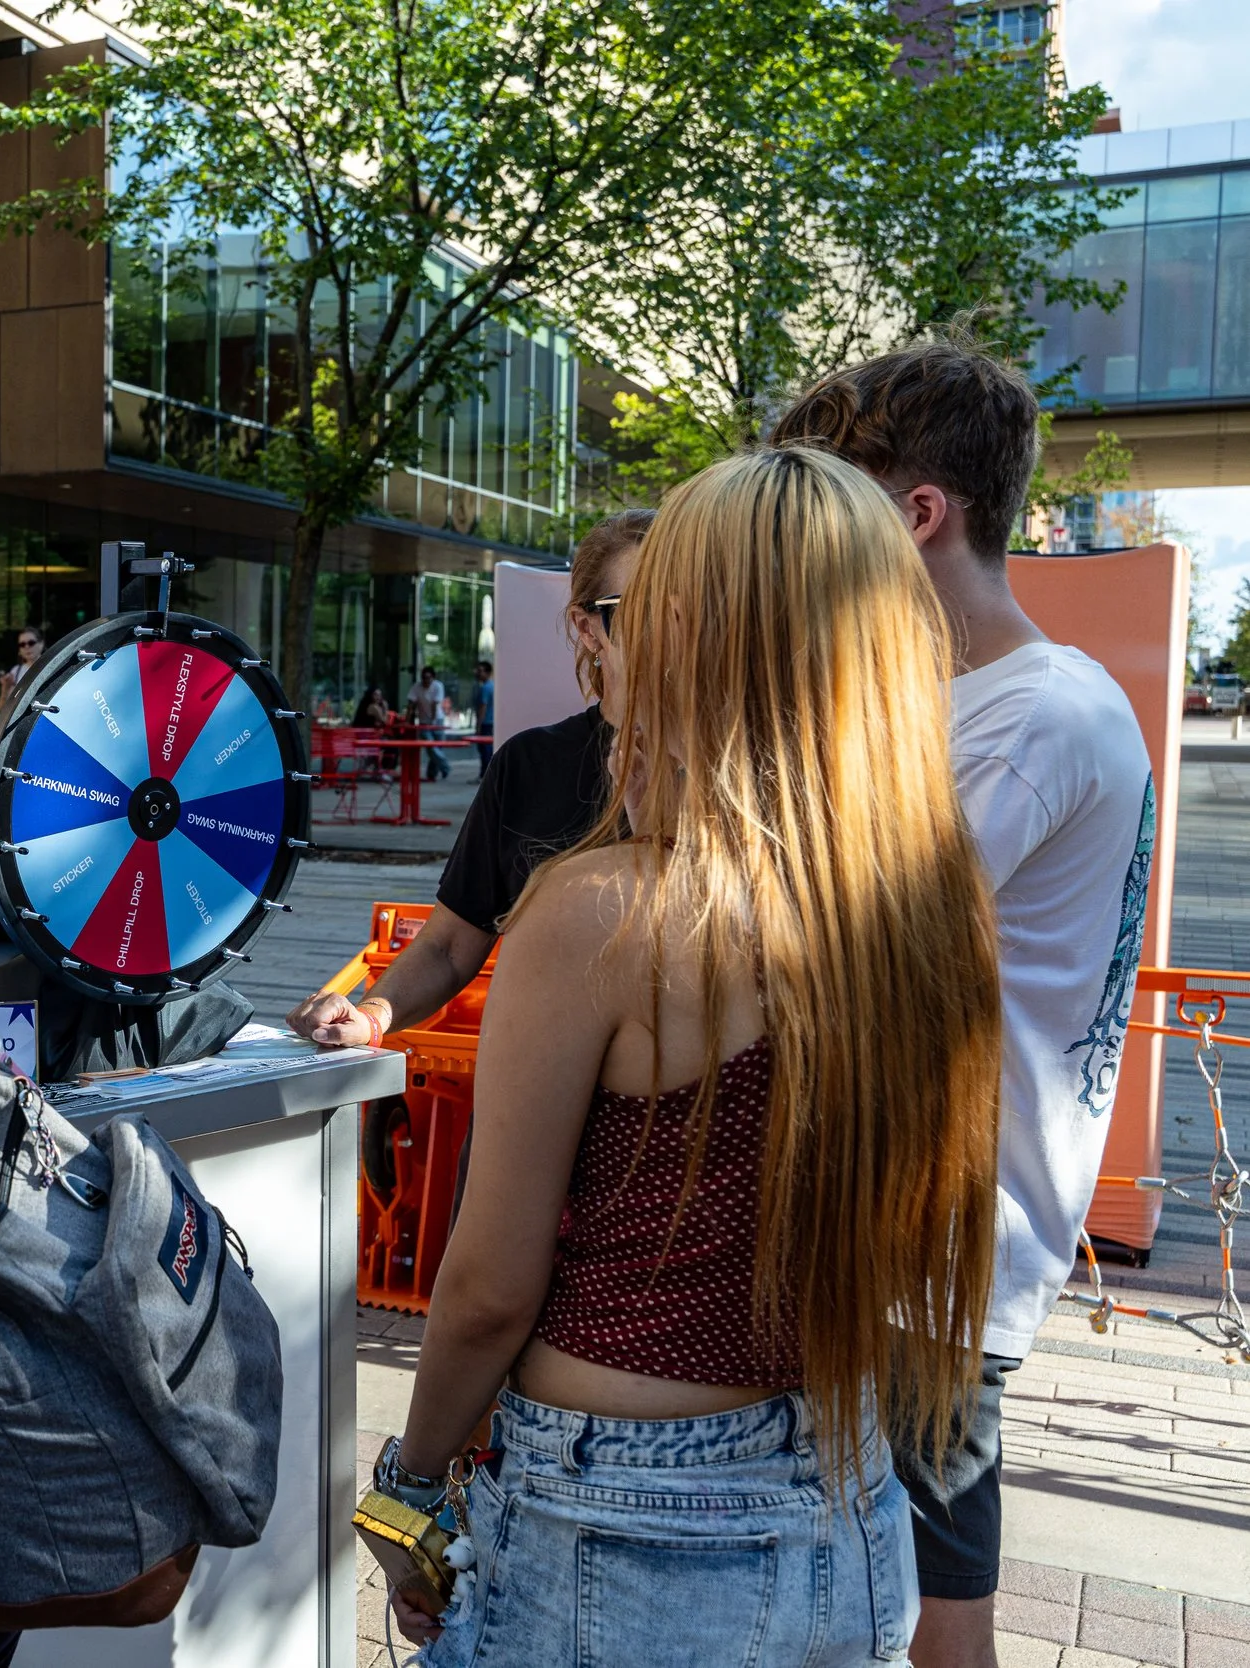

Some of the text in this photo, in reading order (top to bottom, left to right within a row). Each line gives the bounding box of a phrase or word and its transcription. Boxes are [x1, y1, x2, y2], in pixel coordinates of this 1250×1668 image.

[93, 689, 121, 739] STICKER
[163, 653, 194, 762] FLEXSTYLE DROP
[214, 729, 252, 766] STICKER
[89, 789, 120, 807] SWAG
[187, 813, 275, 845] SHARKNINJA SWAG
[53, 855, 94, 894] STICKER
[116, 871, 145, 968] CHILLPILL DROP
[185, 880, 213, 925] STICKER
